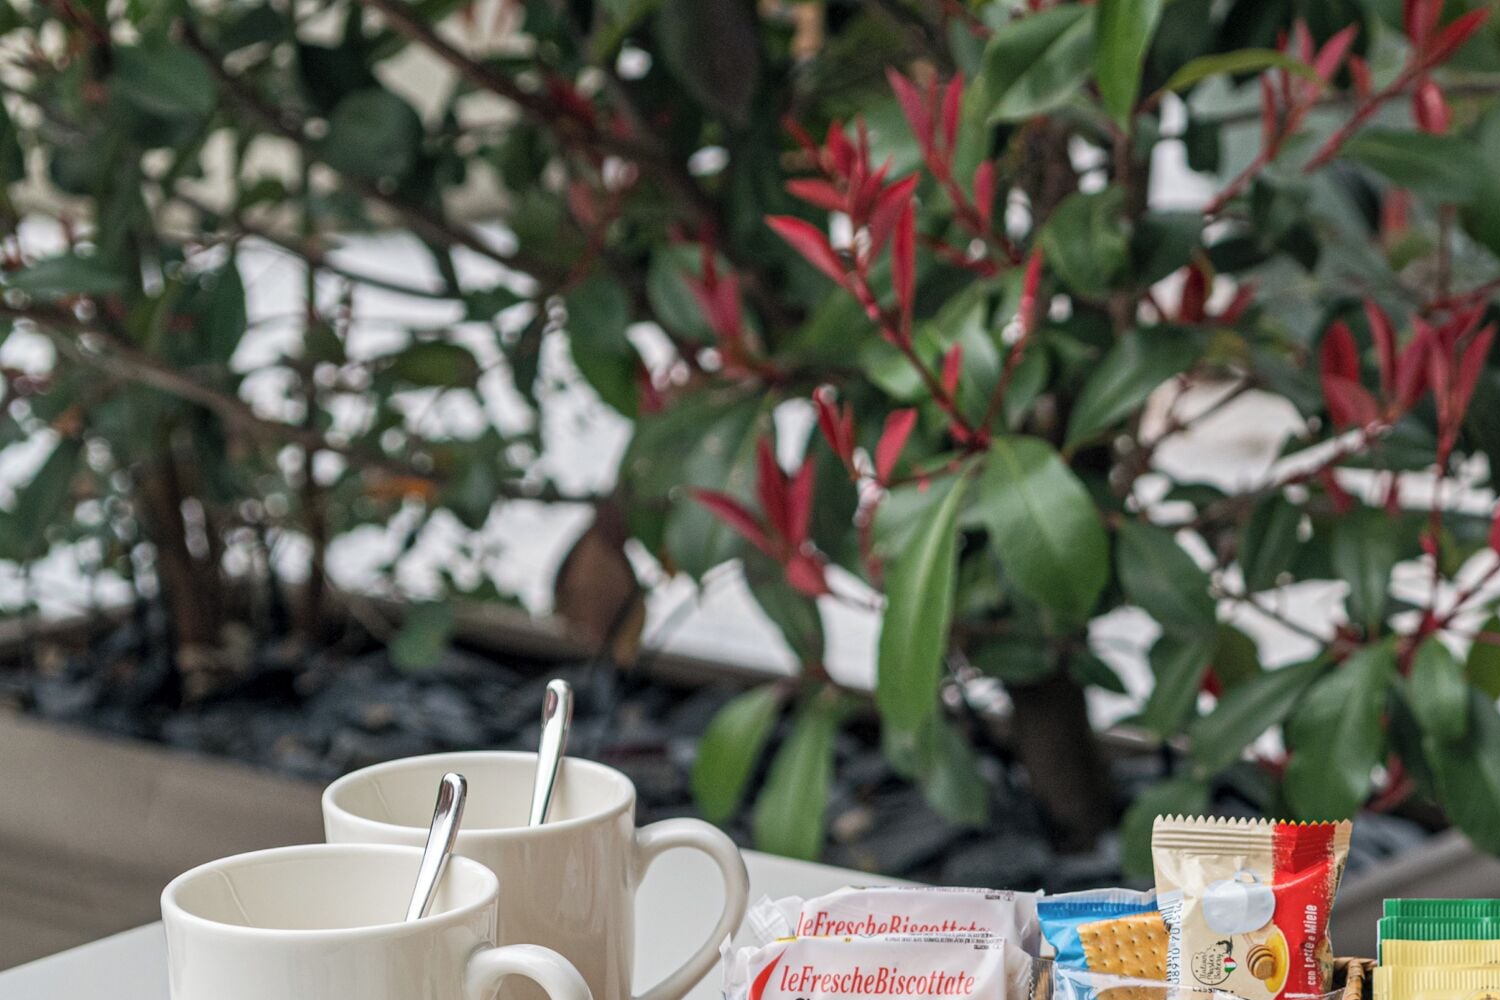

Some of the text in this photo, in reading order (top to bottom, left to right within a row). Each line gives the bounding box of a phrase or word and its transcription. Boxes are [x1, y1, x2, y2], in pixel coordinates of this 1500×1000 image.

[1305, 904, 1317, 934] Miele
[780, 965, 975, 995] leFrescheBiscottate
[1308, 972, 1317, 985] con
